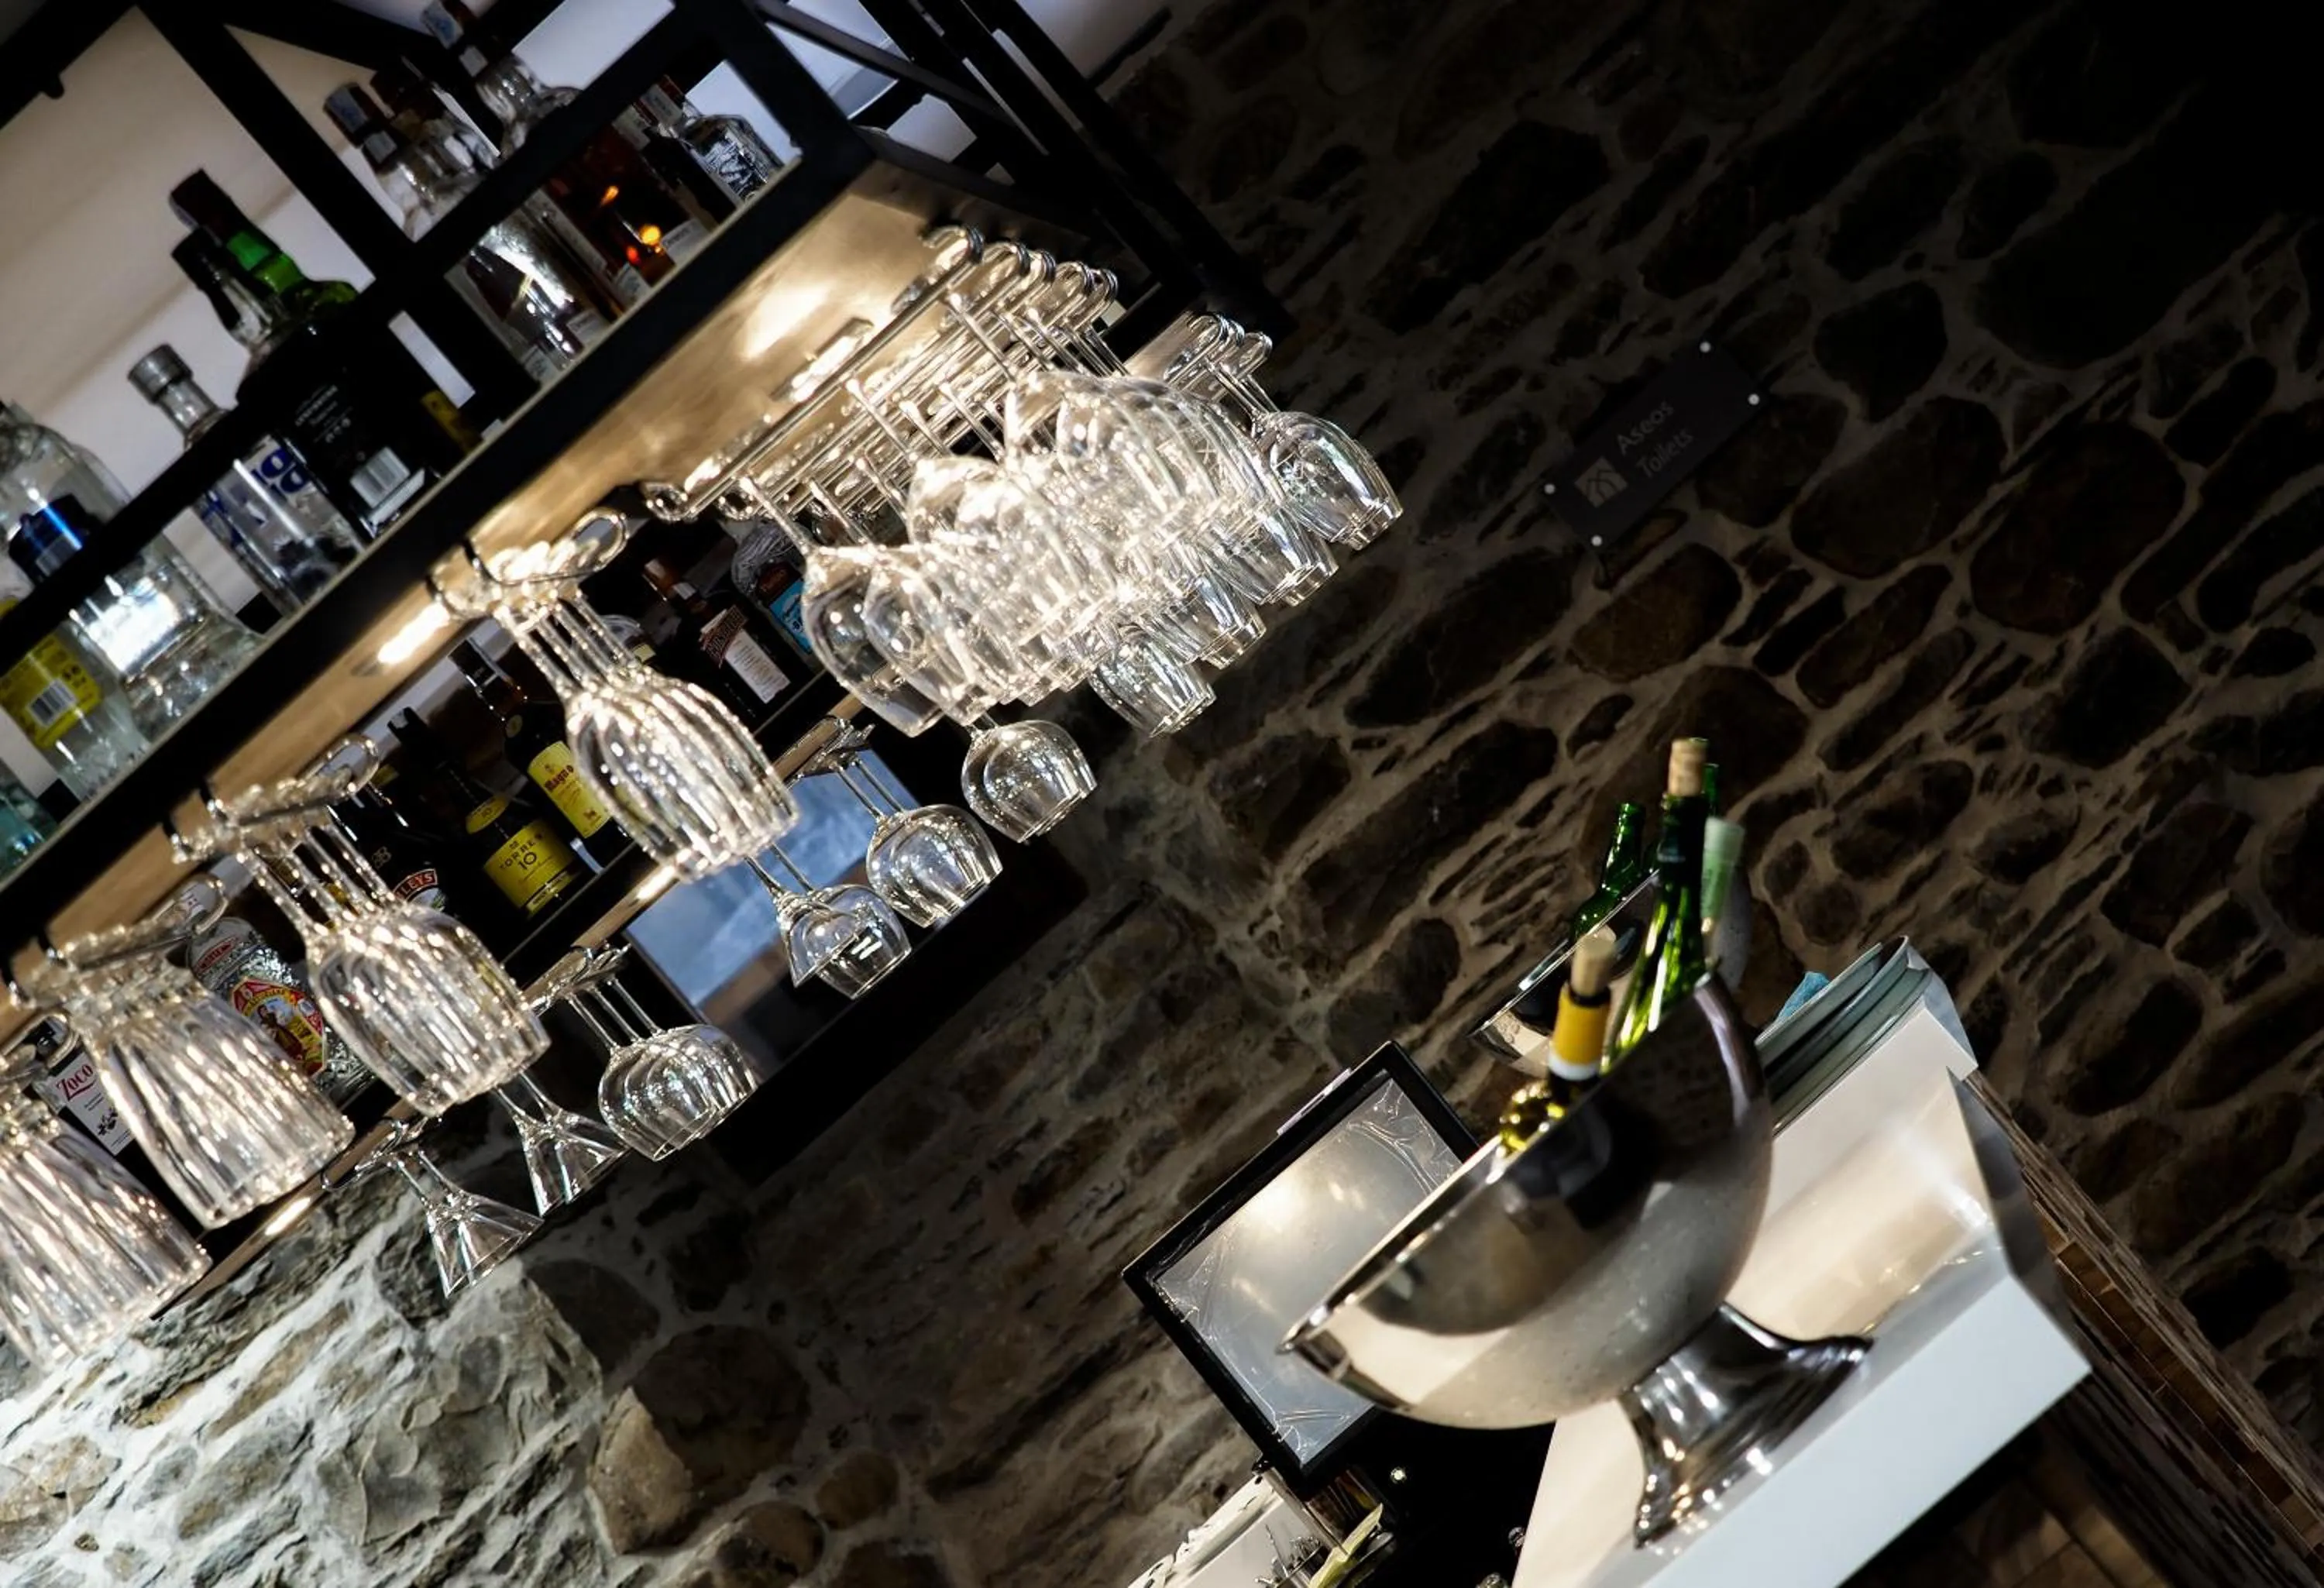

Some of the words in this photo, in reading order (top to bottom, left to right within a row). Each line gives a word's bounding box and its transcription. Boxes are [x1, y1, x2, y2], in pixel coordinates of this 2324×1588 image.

[1617, 401, 1674, 456] Aseos
[1635, 430, 1693, 479] Toilets
[517, 851, 538, 870] 10
[396, 873, 434, 899] LEYS
